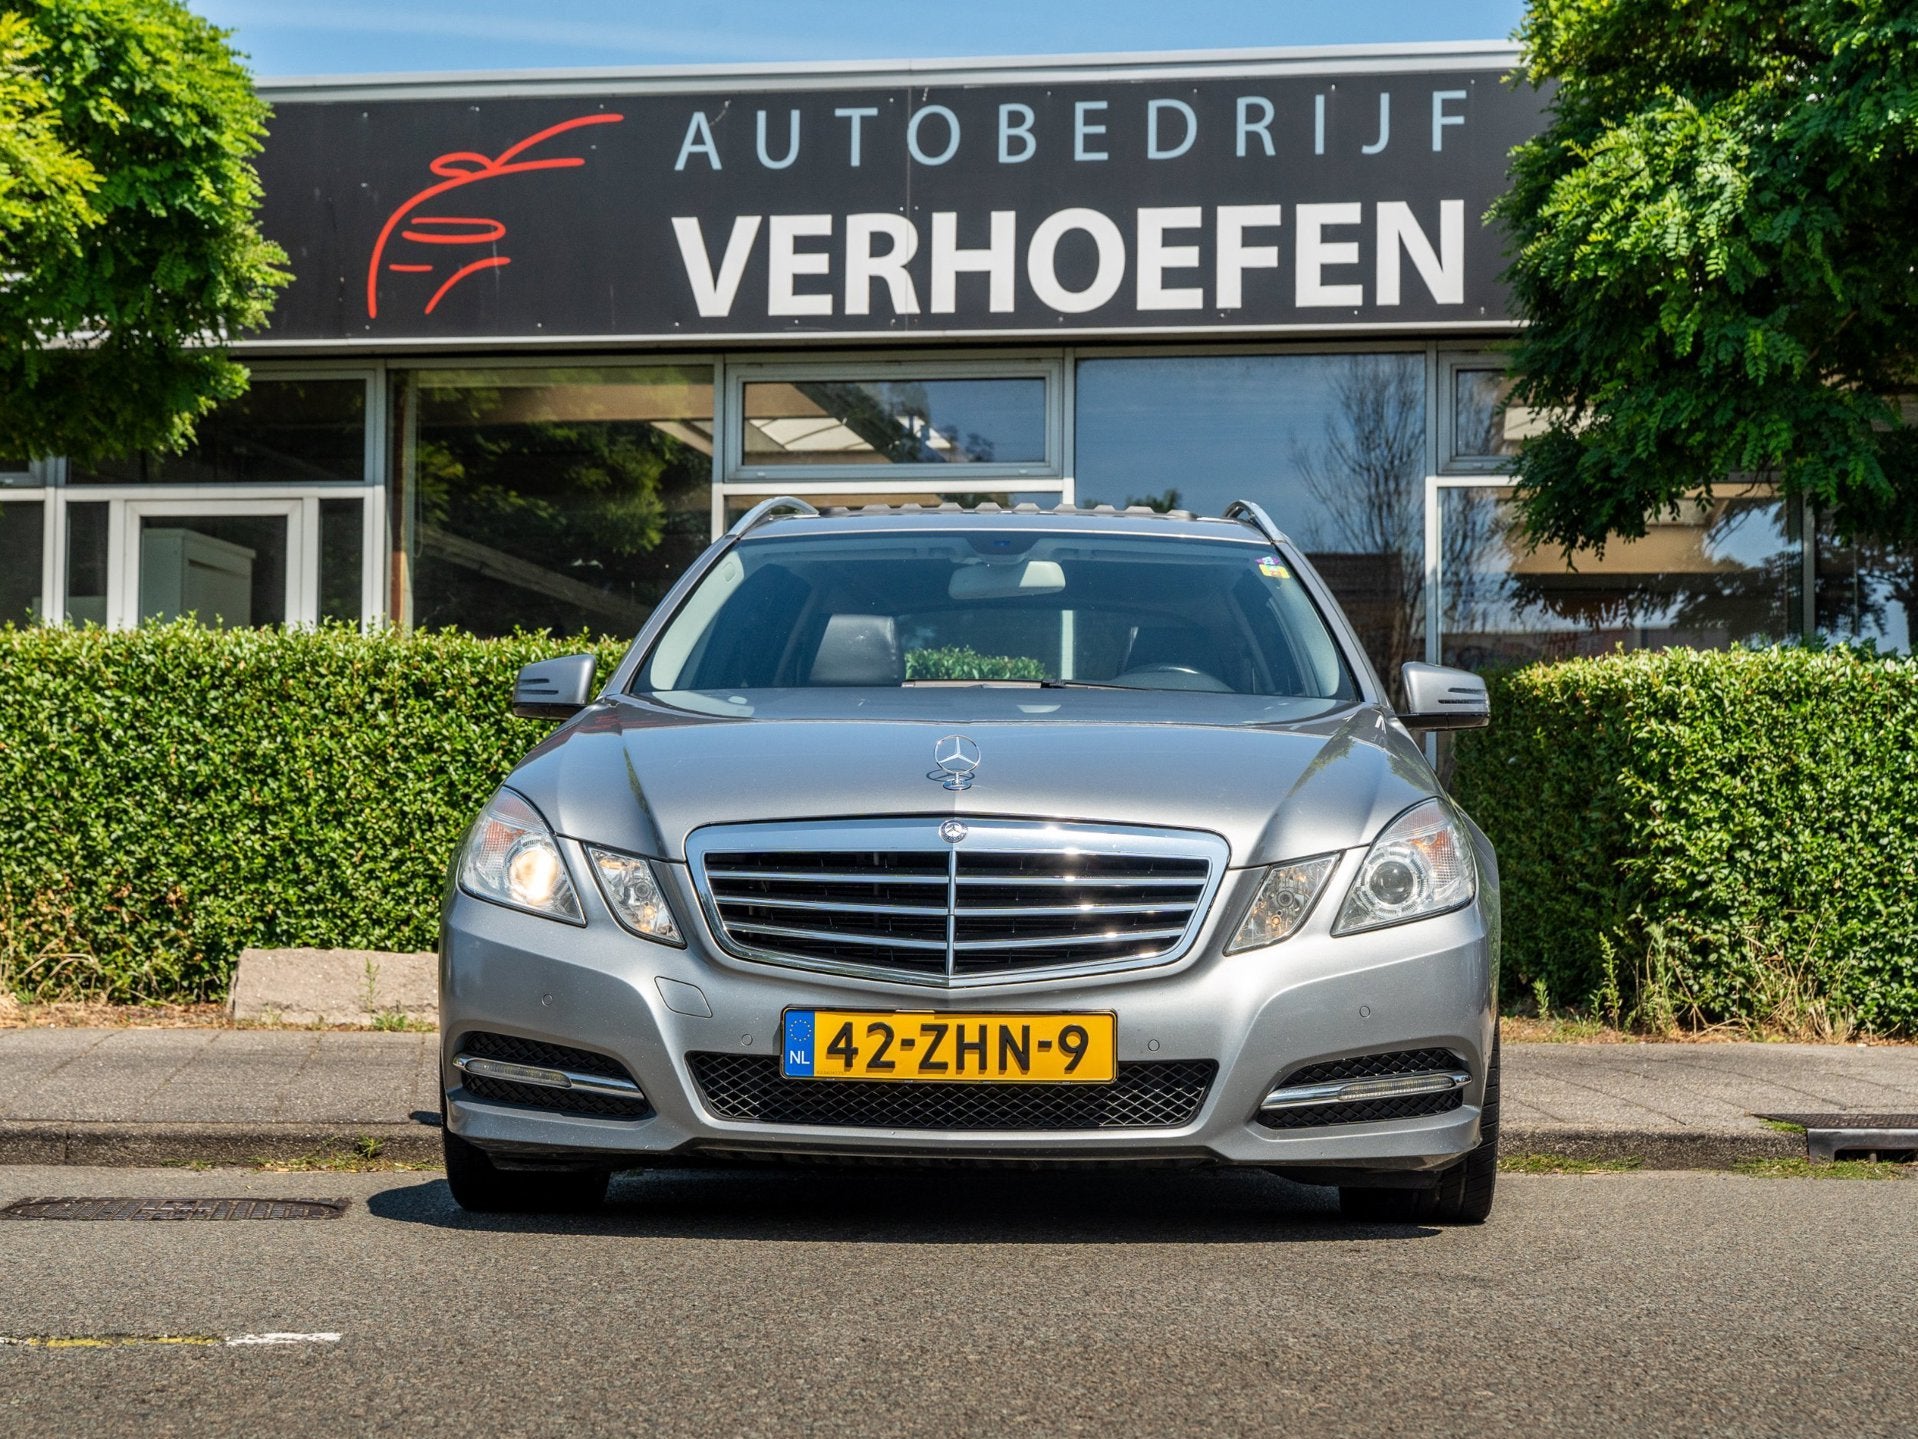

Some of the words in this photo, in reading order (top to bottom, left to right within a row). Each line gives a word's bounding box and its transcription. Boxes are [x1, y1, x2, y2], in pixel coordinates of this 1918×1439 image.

[674, 89, 1467, 171] AUTOBEDRIJF
[672, 199, 1464, 316] VERHOEFEN
[789, 1050, 811, 1065] NL
[826, 1021, 1089, 1074] 42-ZHN-9
